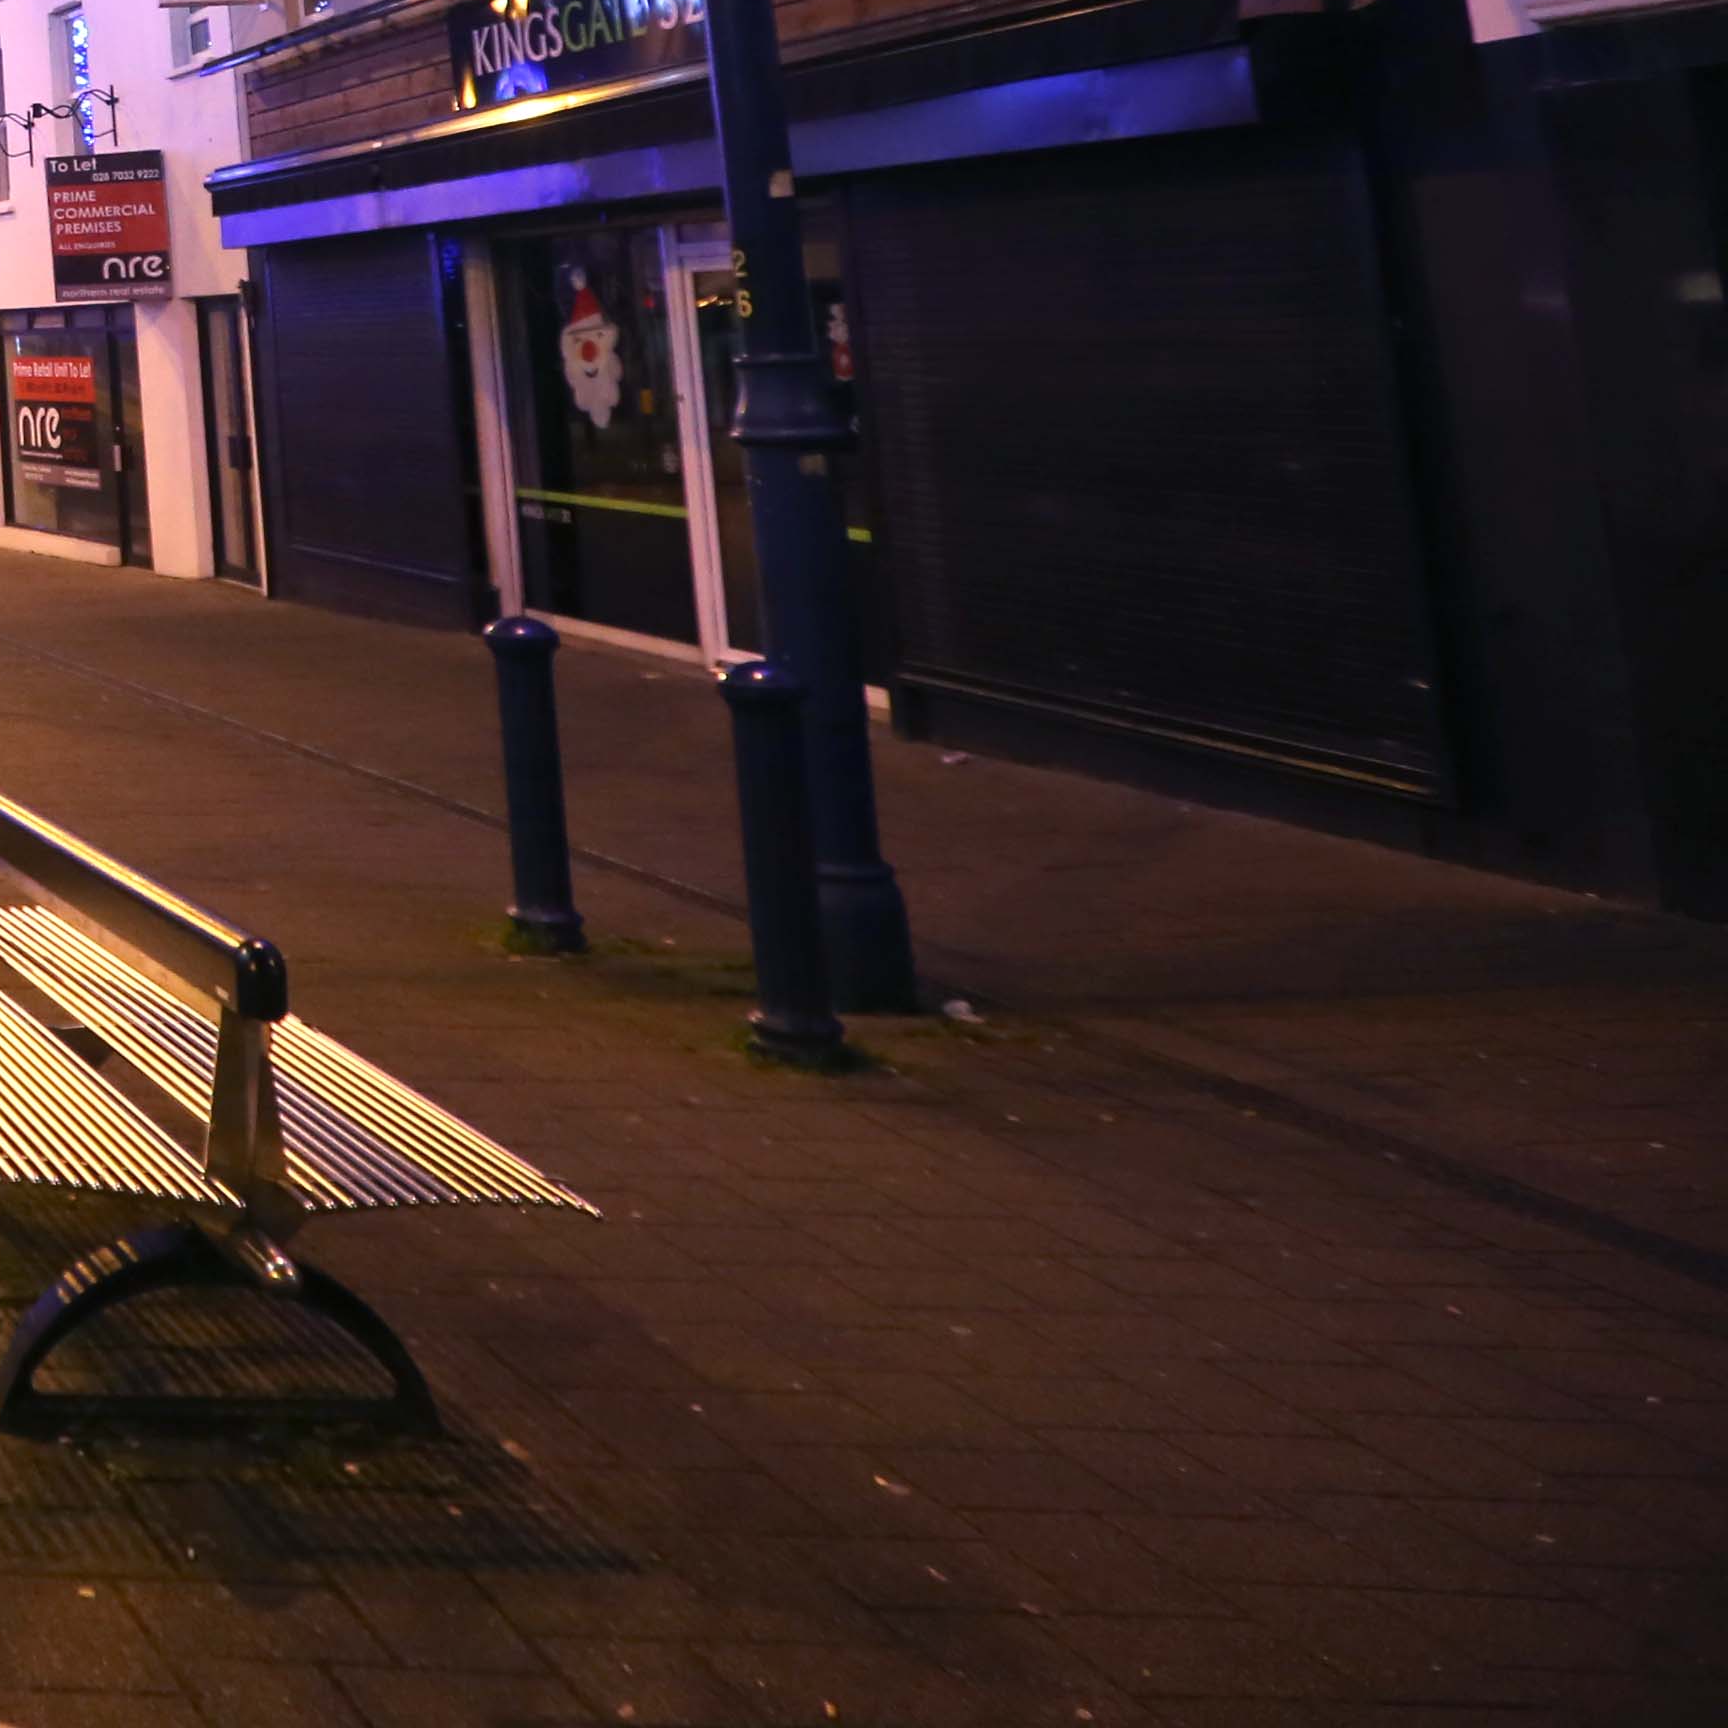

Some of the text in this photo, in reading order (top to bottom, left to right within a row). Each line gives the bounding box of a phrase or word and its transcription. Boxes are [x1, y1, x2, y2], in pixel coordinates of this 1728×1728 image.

[50, 158, 97, 173] To Let
[53, 190, 96, 203] PRIME
[54, 204, 156, 220] COMMERCIAL
[55, 221, 122, 235] PREMISES
[103, 255, 164, 279] nre
[19, 405, 62, 449] nre
